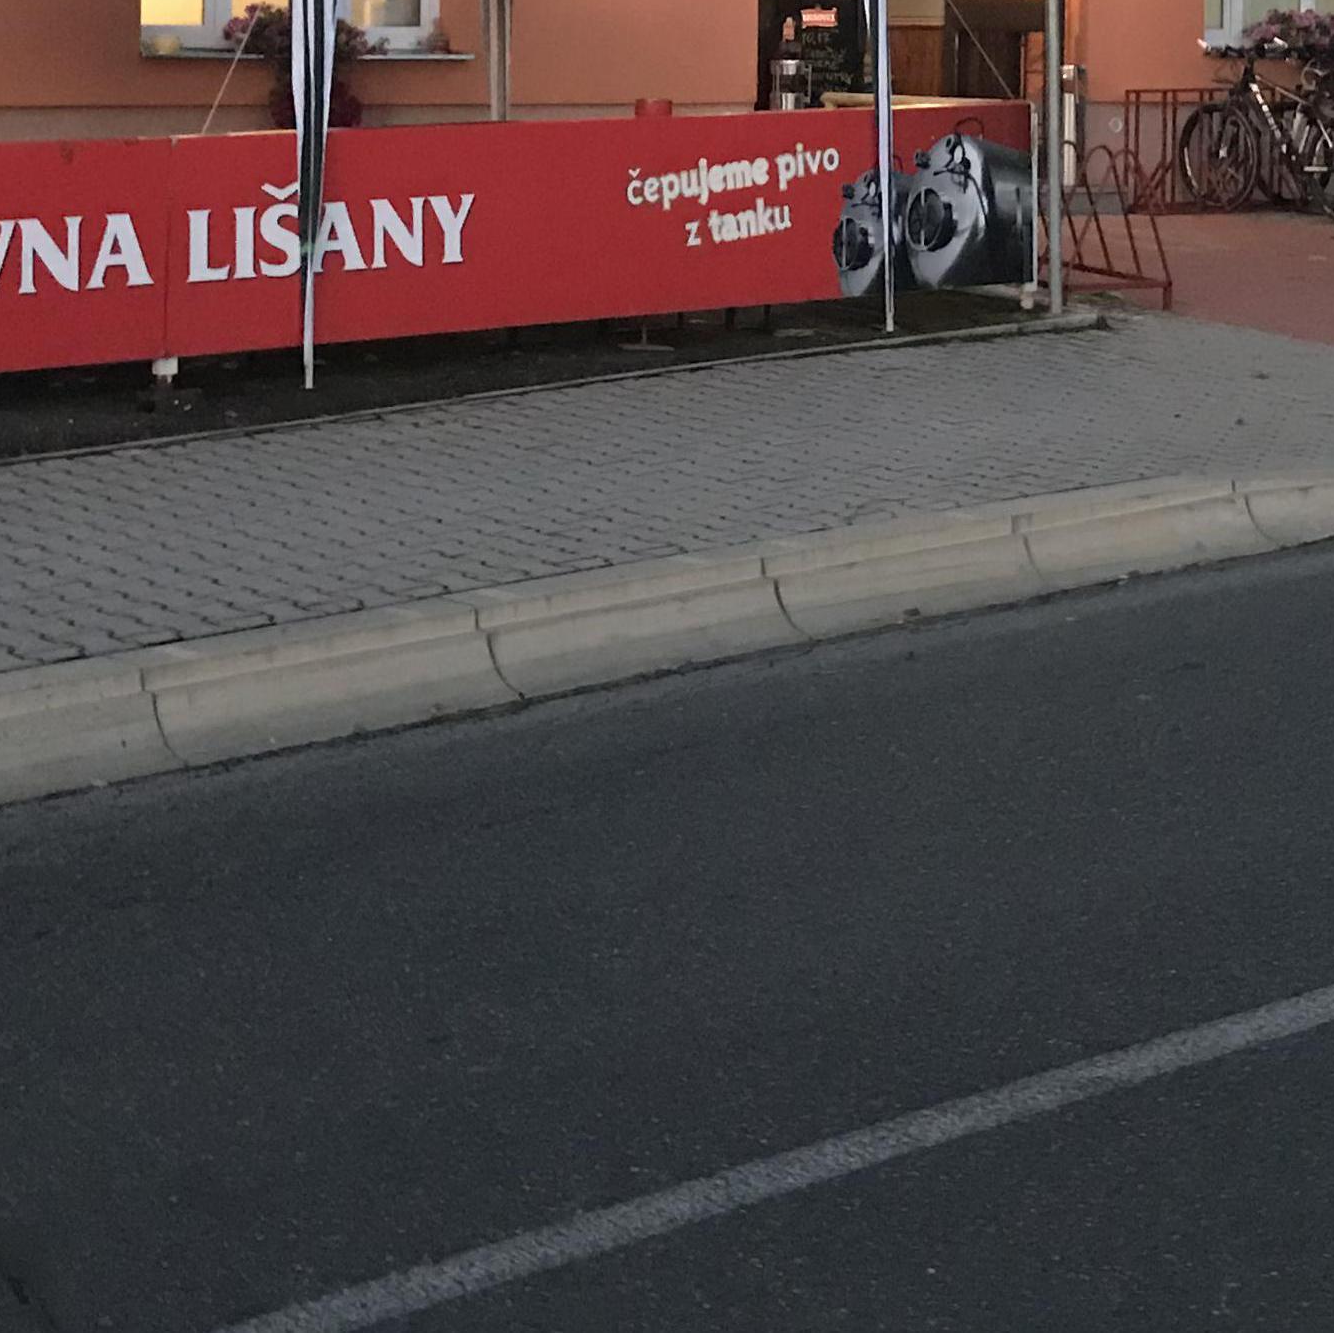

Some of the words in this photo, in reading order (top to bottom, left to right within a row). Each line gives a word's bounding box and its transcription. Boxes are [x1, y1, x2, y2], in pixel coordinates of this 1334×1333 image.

[626, 157, 770, 209] čepujeme
[775, 142, 840, 191] pivo
[186, 181, 475, 283] LIŠANY
[684, 220, 701, 247] z
[708, 198, 792, 244] tanku
